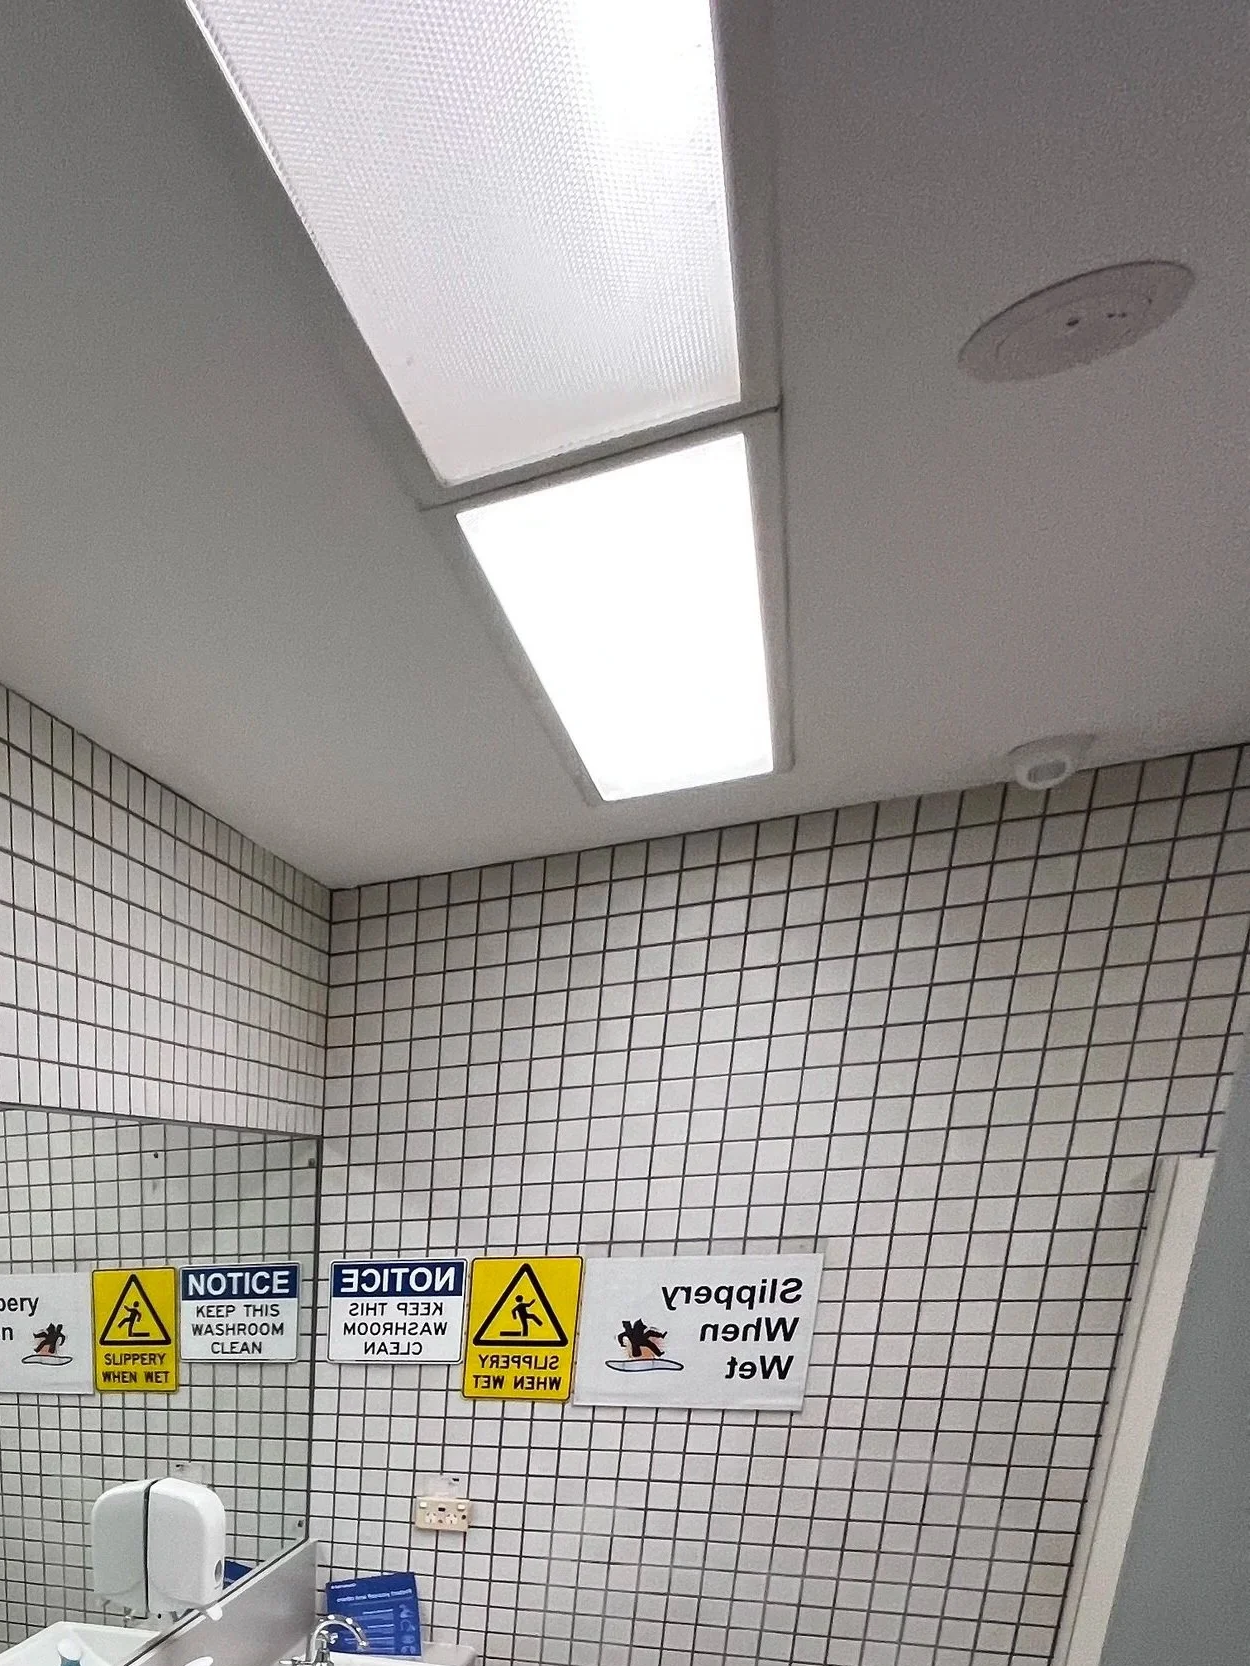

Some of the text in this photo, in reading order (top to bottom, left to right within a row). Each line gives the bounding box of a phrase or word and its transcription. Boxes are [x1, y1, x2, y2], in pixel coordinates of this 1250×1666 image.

[188, 1270, 290, 1296] NOTICE
[196, 1304, 280, 1318] KEEP THIS
[192, 1322, 284, 1336] WASHROOM
[211, 1341, 262, 1354] CLEAN
[104, 1353, 166, 1366] SLIPPERY
[102, 1371, 169, 1384] WHEN WET
